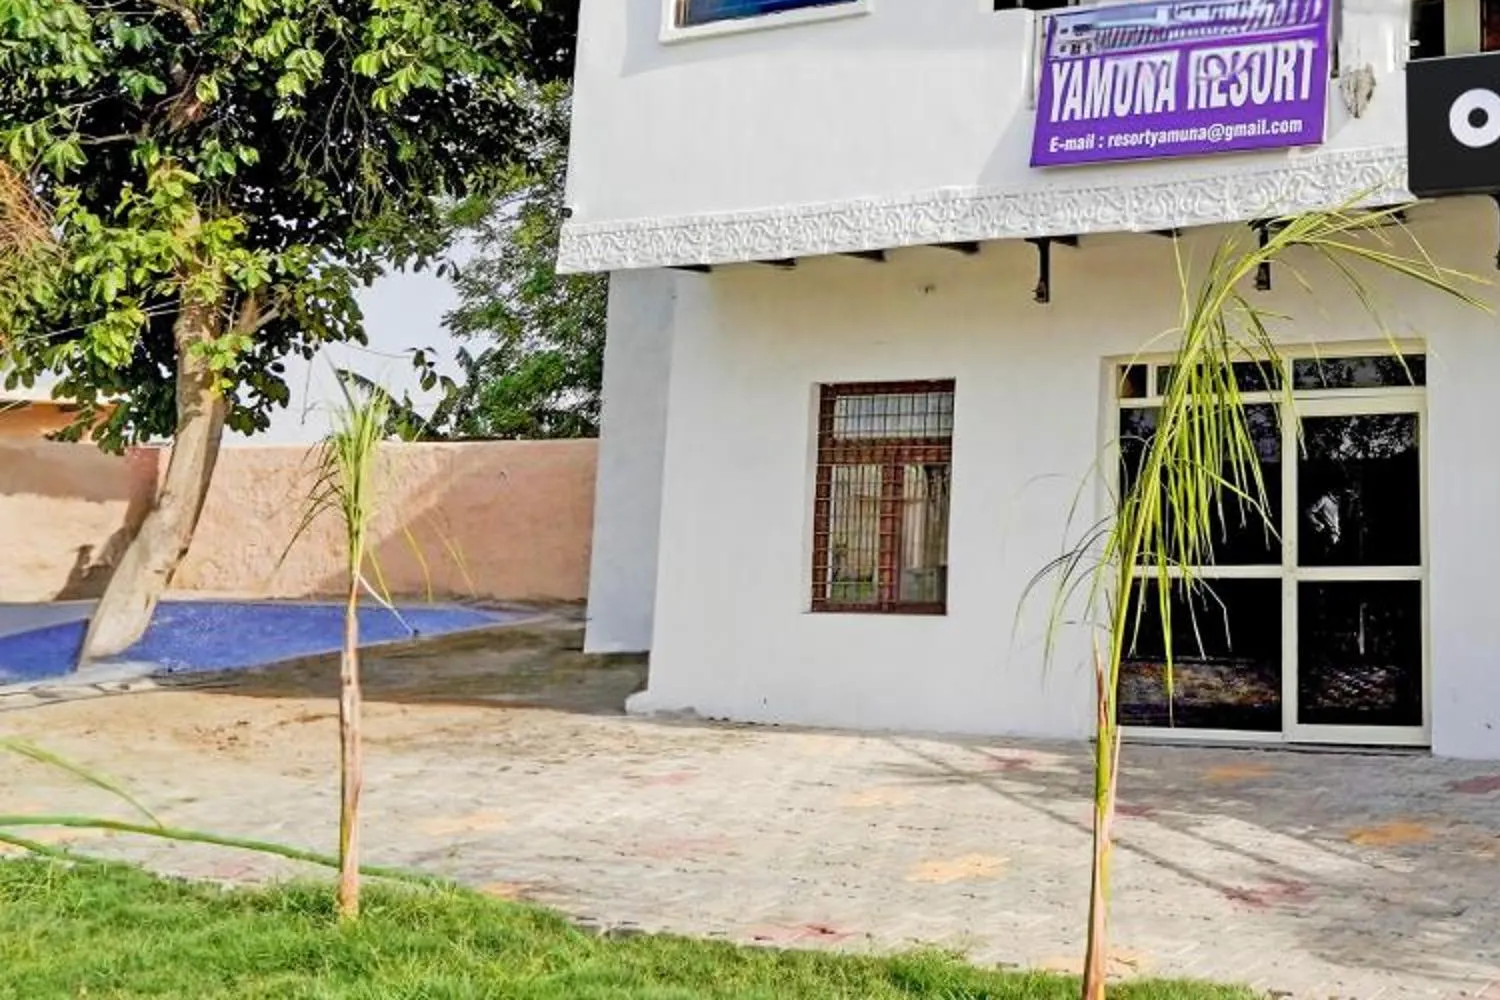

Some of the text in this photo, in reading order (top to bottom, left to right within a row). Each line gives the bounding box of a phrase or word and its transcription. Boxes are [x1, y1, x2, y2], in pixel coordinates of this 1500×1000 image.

[1050, 39, 1318, 122] YAMUNA RESORT
[1050, 131, 1095, 153] E-mail
[1108, 118, 1302, 149] resortyamuna@gmail.com
